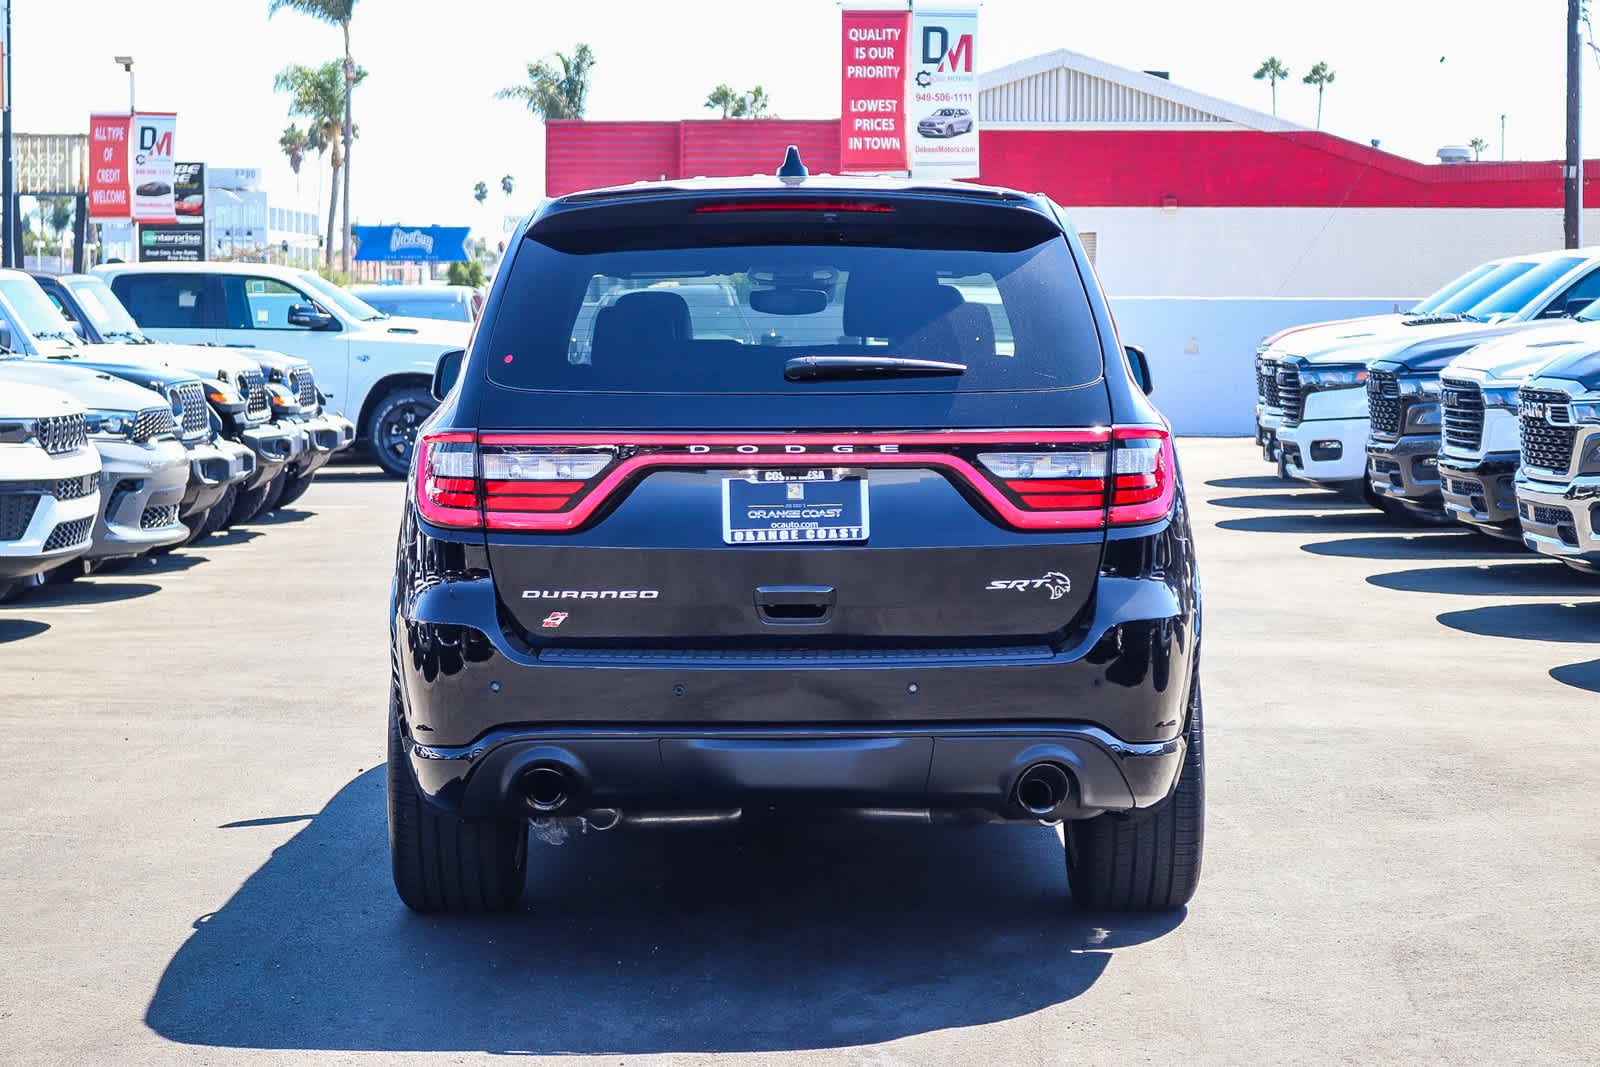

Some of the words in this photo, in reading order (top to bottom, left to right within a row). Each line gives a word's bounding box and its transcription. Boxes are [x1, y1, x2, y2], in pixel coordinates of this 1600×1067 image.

[849, 28, 901, 41] QUALITY
[855, 47, 866, 59] IS
[868, 47, 895, 59] OUR
[922, 26, 973, 73] DM
[847, 65, 900, 78] PRIORITY
[915, 93, 972, 102] 949-506-1111
[851, 100, 898, 112] LOWEST
[855, 118, 895, 131] PRICES
[95, 126, 106, 141] ALL
[108, 127, 124, 141] TYPE
[140, 126, 172, 157] DM
[849, 137, 861, 150] IN
[864, 137, 900, 150] TOWN
[103, 147, 113, 162] OF
[96, 168, 121, 183] CREDIT
[92, 190, 126, 205] WELCOME
[690, 444, 900, 454] DODGE
[747, 509, 801, 519] ORANGE
[801, 508, 843, 518] COAST
[770, 521, 819, 529] ocauto.com
[733, 530, 798, 542] ORANGE
[806, 528, 859, 540] COAST
[985, 579, 1051, 592] SRT
[521, 590, 659, 599] DURANGO
